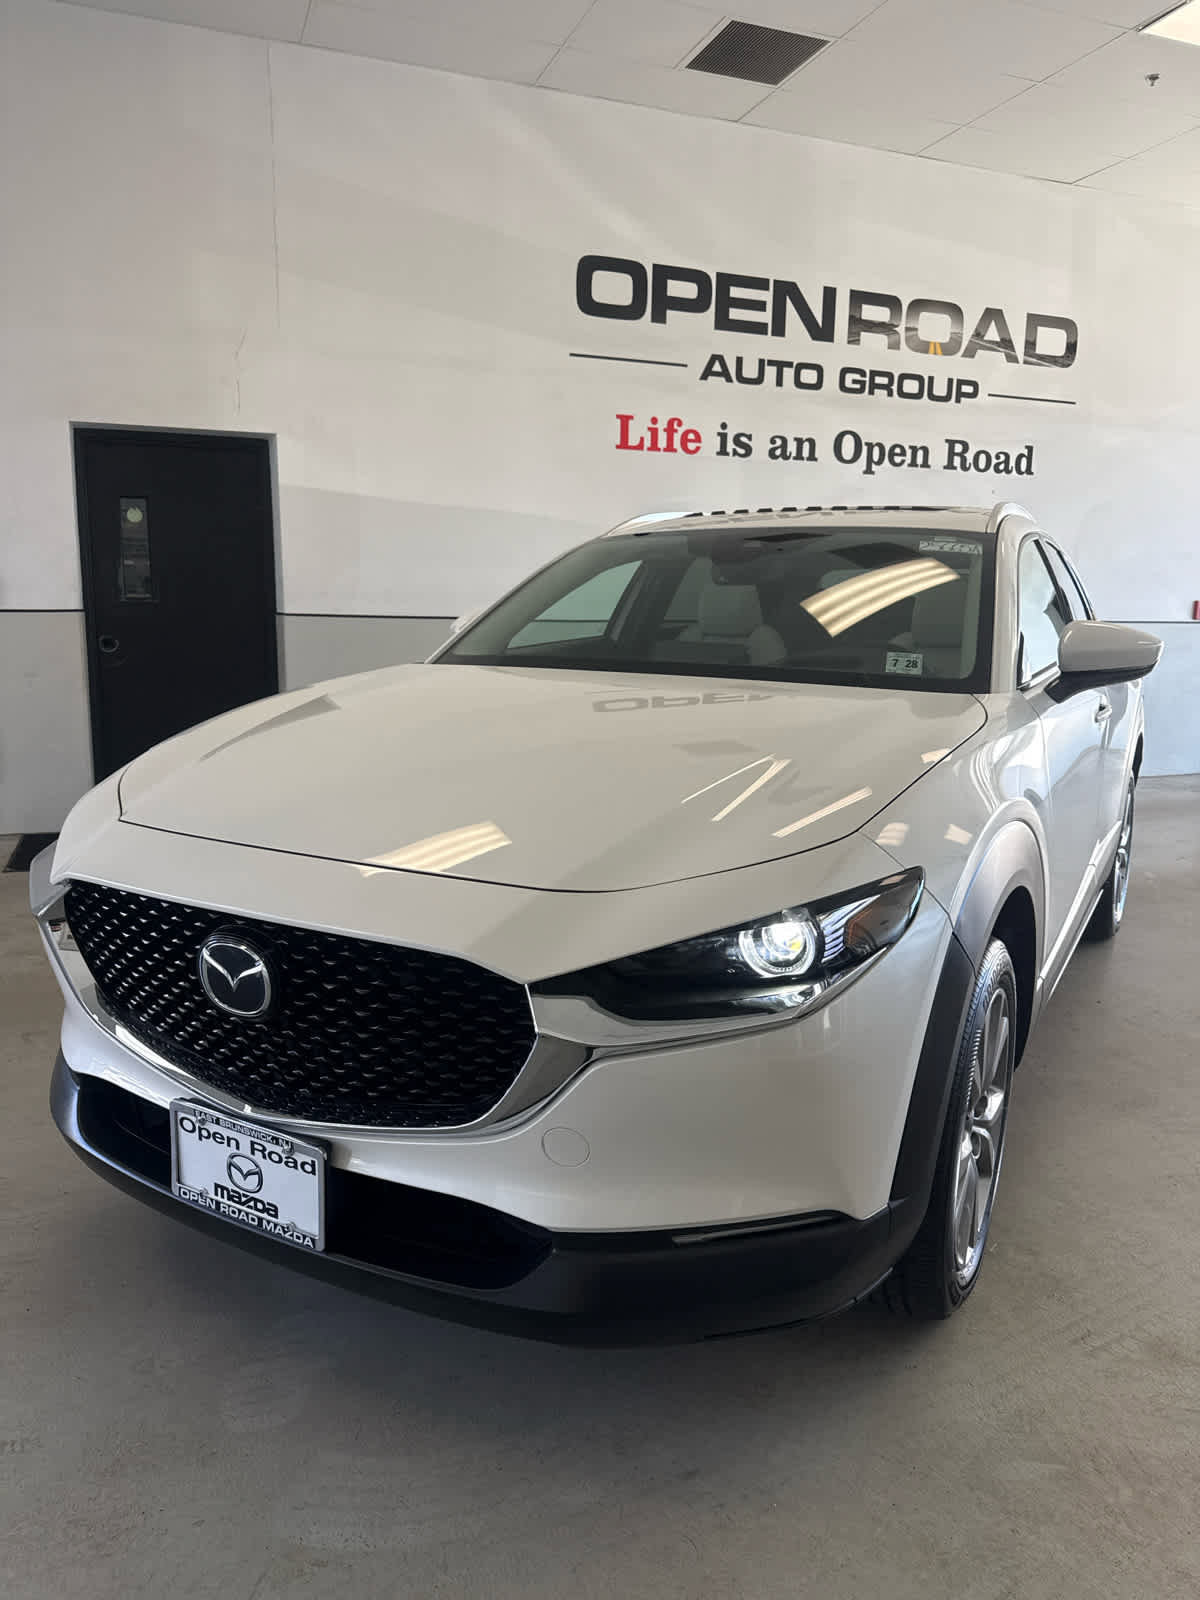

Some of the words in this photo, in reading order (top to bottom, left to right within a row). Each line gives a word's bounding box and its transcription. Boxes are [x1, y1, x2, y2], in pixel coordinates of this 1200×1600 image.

[576, 255, 837, 344] OPEN
[847, 288, 1079, 369] ROAD
[699, 354, 824, 391] AUTO
[838, 367, 980, 404] GROUP
[615, 413, 703, 456] Life
[716, 422, 754, 459] is
[768, 433, 818, 463] an
[833, 430, 932, 475] Open
[943, 439, 1035, 476] Road
[179, 1116, 240, 1151] Open
[250, 1140, 317, 1176] Road
[195, 1110, 216, 1124] EAST
[180, 1188, 216, 1211] OPEN
[220, 1203, 258, 1226] ROAD
[262, 1221, 314, 1249] MAZDA
